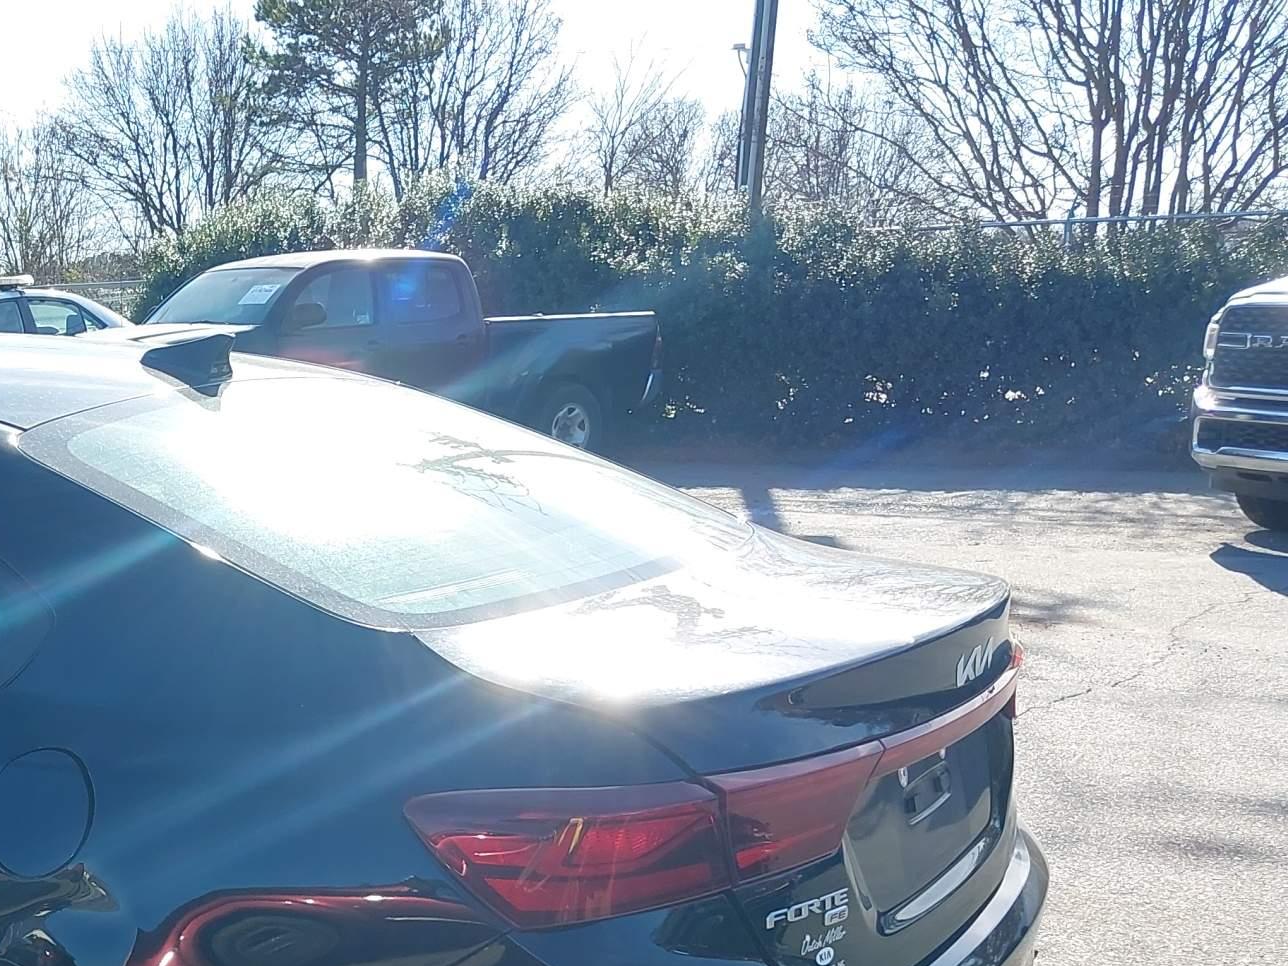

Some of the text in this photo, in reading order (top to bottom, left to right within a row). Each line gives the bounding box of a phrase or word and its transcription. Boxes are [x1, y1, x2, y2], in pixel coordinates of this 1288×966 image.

[956, 636, 993, 688] KIA
[766, 887, 849, 930] FORTE
[818, 950, 832, 963] KIA
